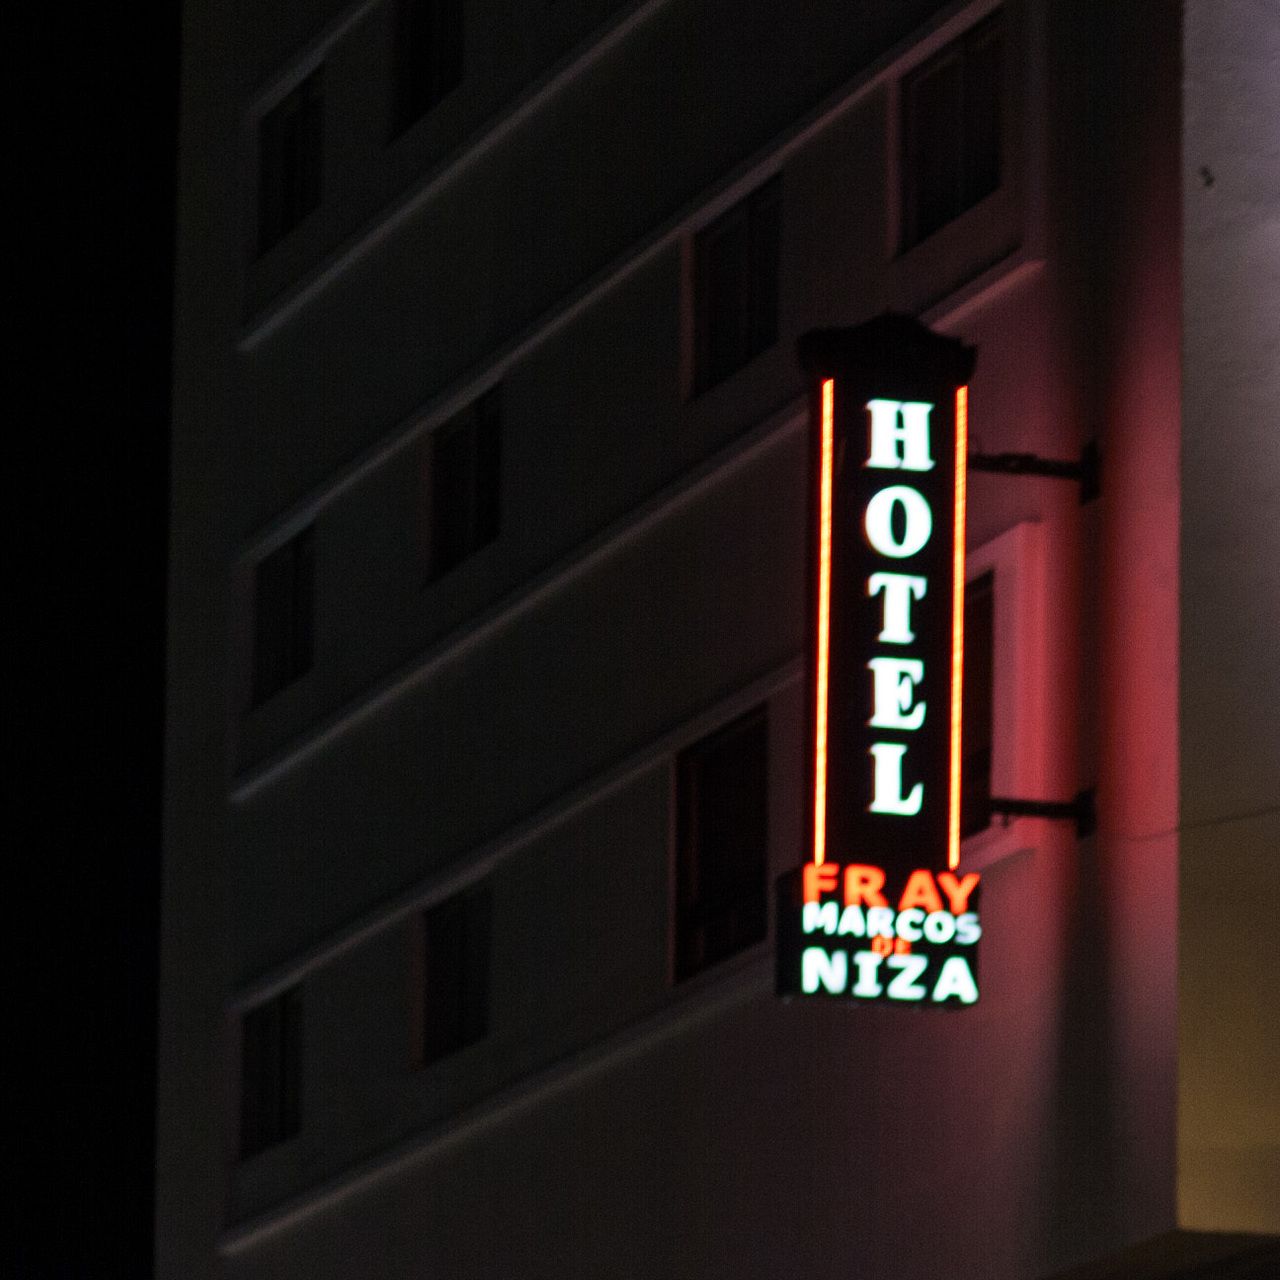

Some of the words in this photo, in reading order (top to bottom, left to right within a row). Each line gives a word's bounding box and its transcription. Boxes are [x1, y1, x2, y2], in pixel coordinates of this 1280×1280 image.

[865, 399, 935, 816] HOTEL
[803, 863, 981, 914] FRAY
[802, 901, 982, 945] MARCOS
[801, 946, 979, 1004] NIZA
